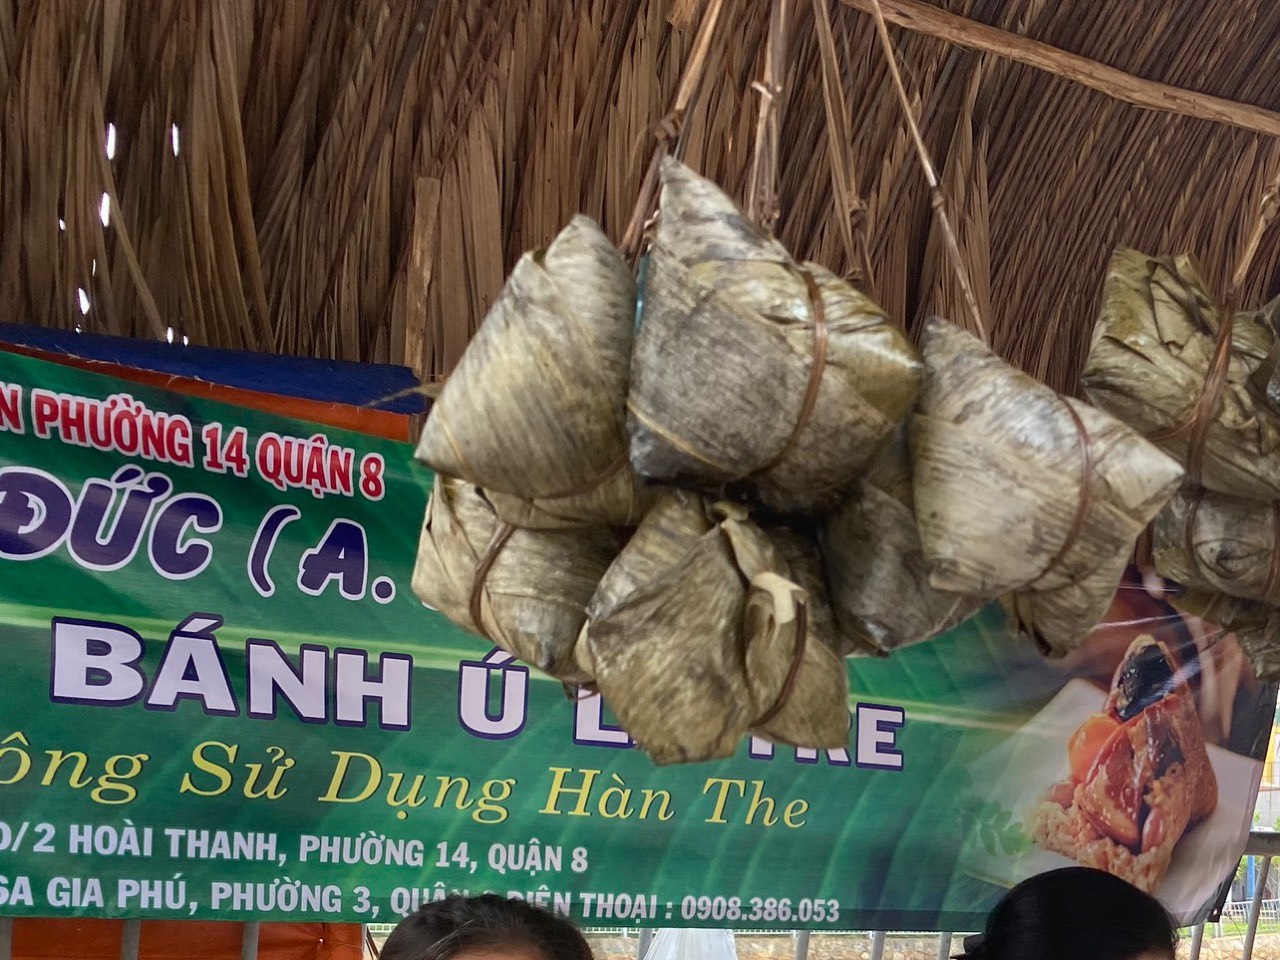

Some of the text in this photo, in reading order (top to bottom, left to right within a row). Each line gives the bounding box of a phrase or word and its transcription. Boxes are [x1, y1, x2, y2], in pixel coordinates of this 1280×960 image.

[31, 388, 194, 469] PHƯỜNG
[203, 422, 249, 478] 14
[256, 433, 355, 499] QUẬN
[359, 452, 385, 501] 8
[50, 612, 414, 731] BÁNH
[459, 646, 529, 740] Ú
[179, 741, 296, 800] Sử
[318, 751, 516, 823] Dụng
[538, 767, 675, 821] Hàn
[702, 777, 811, 829] The
[69, 819, 153, 857] HOÀI
[164, 829, 287, 866] THANH,
[299, 830, 424, 867] PHƯỜNG
[436, 842, 477, 873] 14,
[488, 838, 563, 877] QUẬN
[571, 846, 588, 873] 8
[46, 876, 105, 907] GIA
[118, 872, 198, 916] PHÚ,
[211, 876, 342, 913] PHƯỜNG
[352, 890, 380, 918] 3,
[580, 891, 657, 922] THOẠI
[682, 895, 840, 923] 0908.386.053
